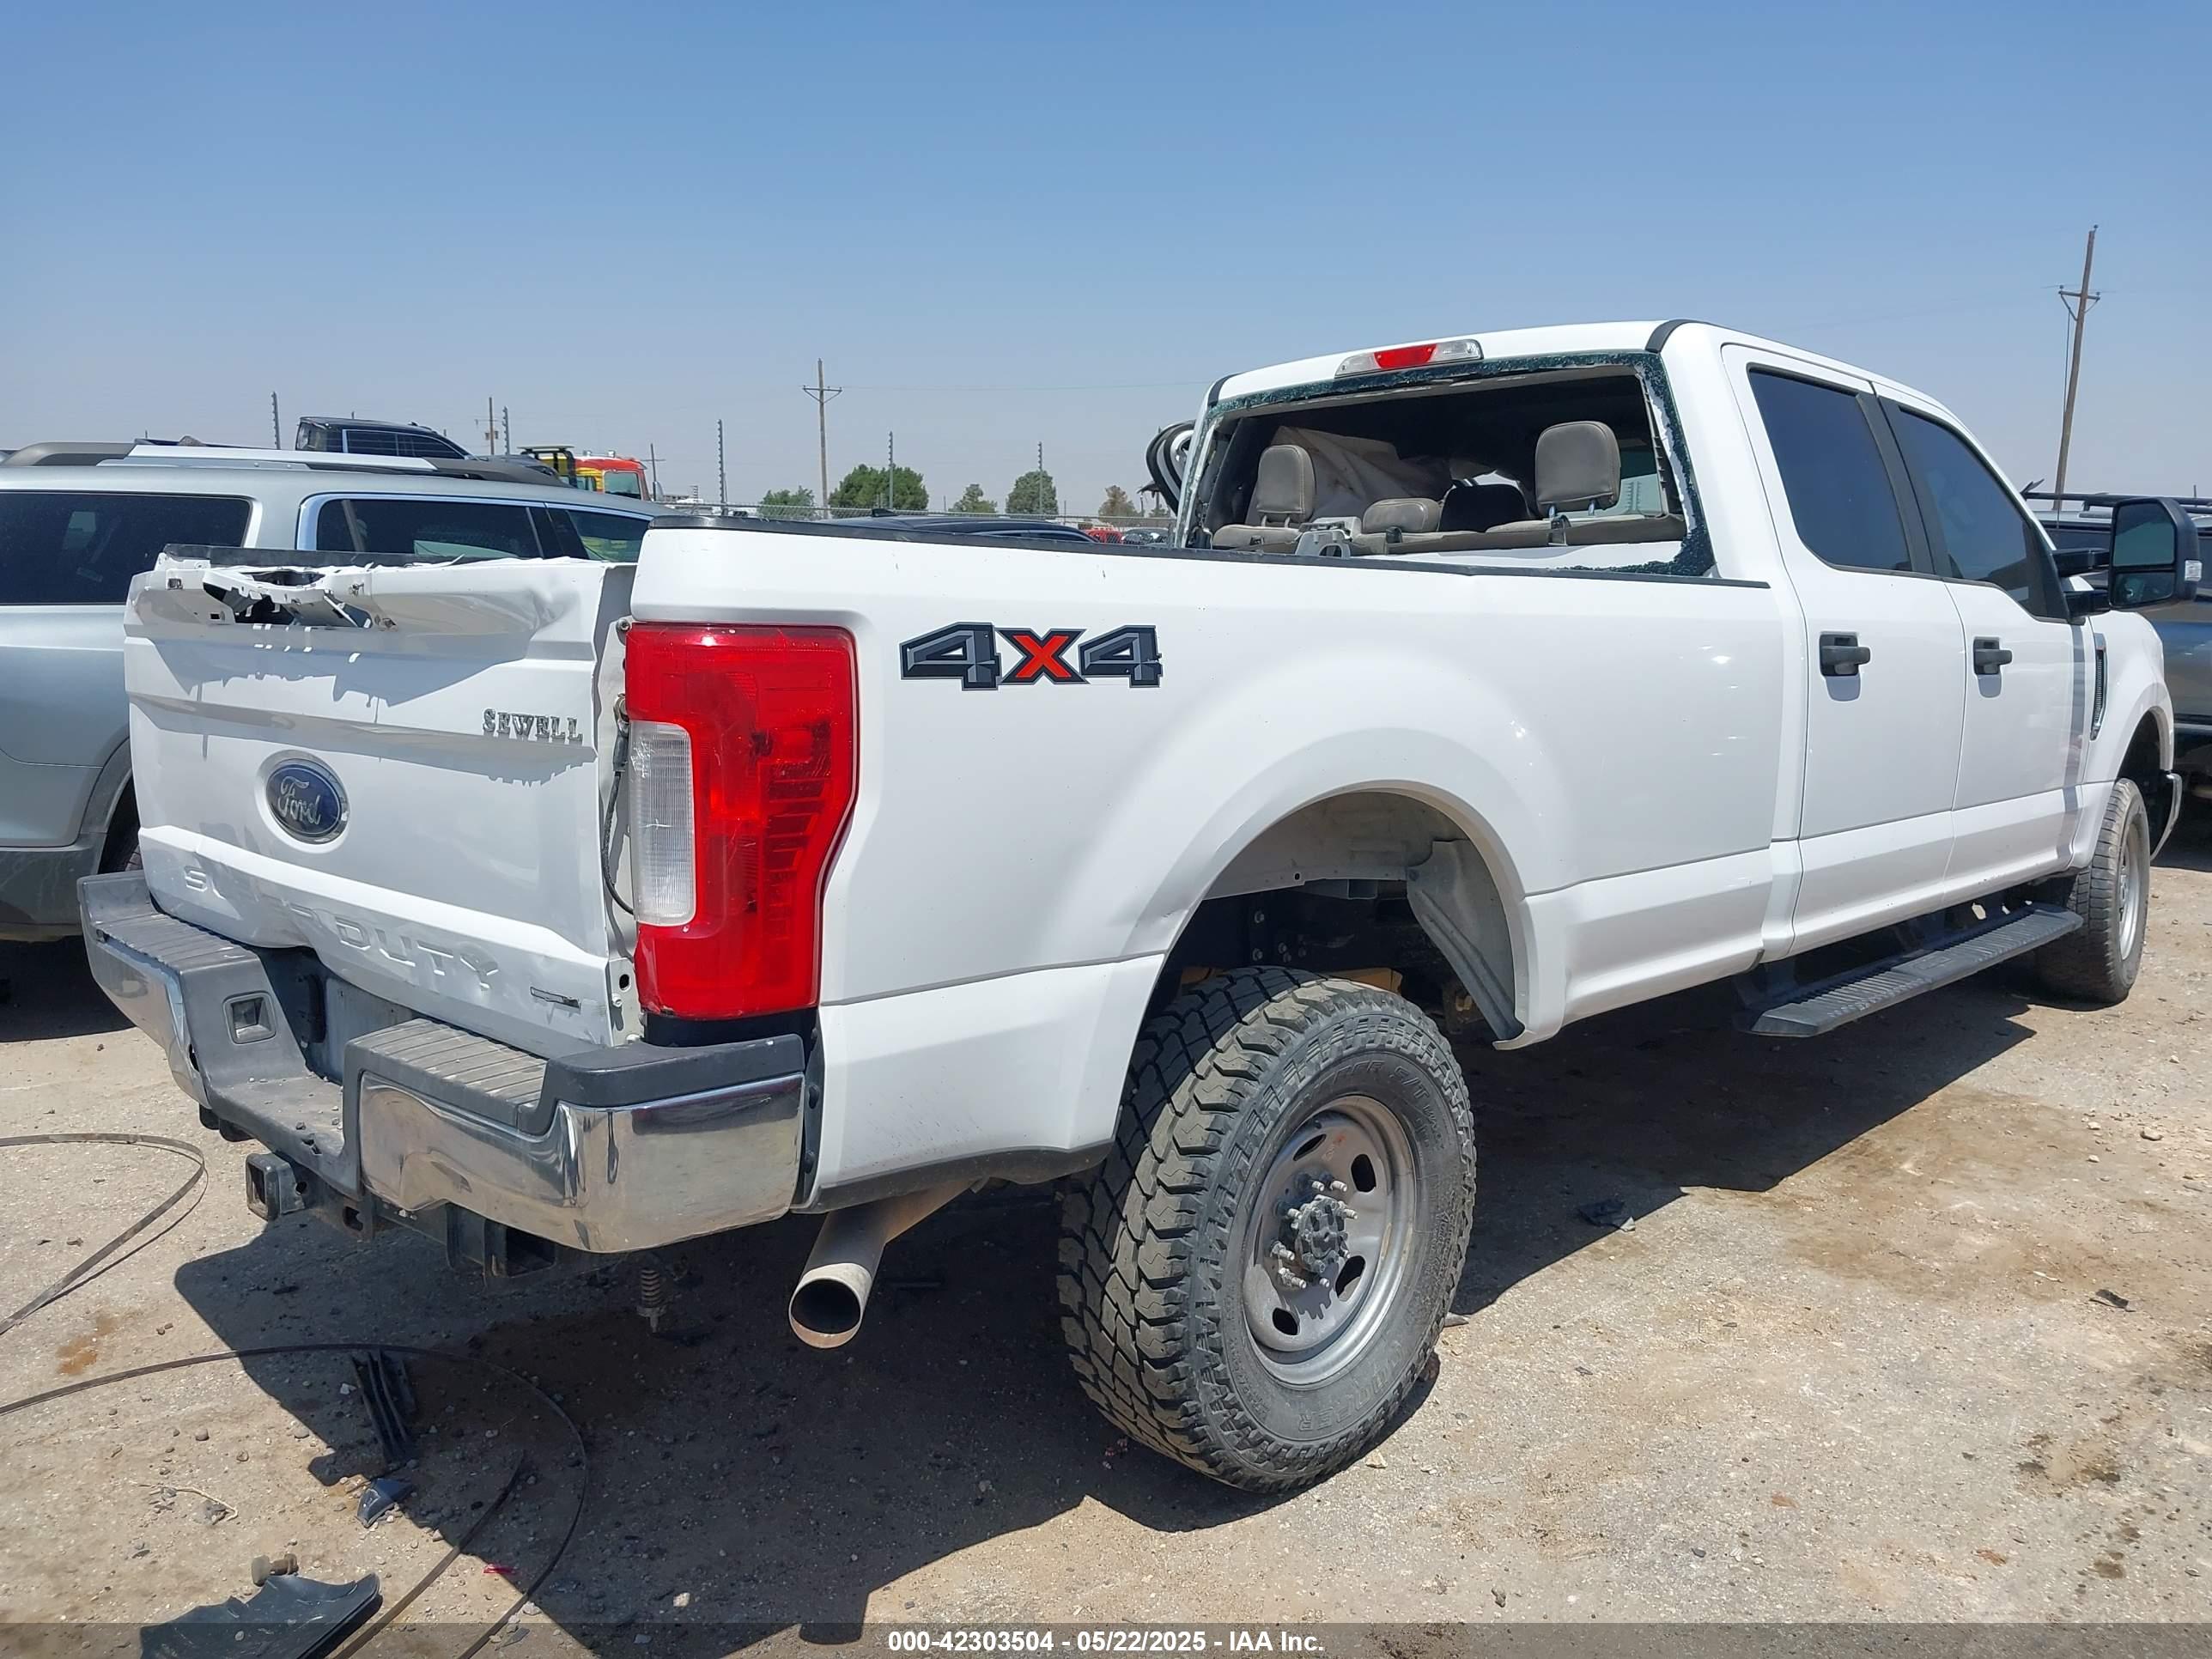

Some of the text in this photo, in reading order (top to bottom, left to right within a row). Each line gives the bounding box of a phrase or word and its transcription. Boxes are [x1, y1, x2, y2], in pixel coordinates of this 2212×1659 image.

[483, 708, 583, 741] SEWELL
[278, 775, 322, 825] Ford
[335, 916, 500, 990] DUTY
